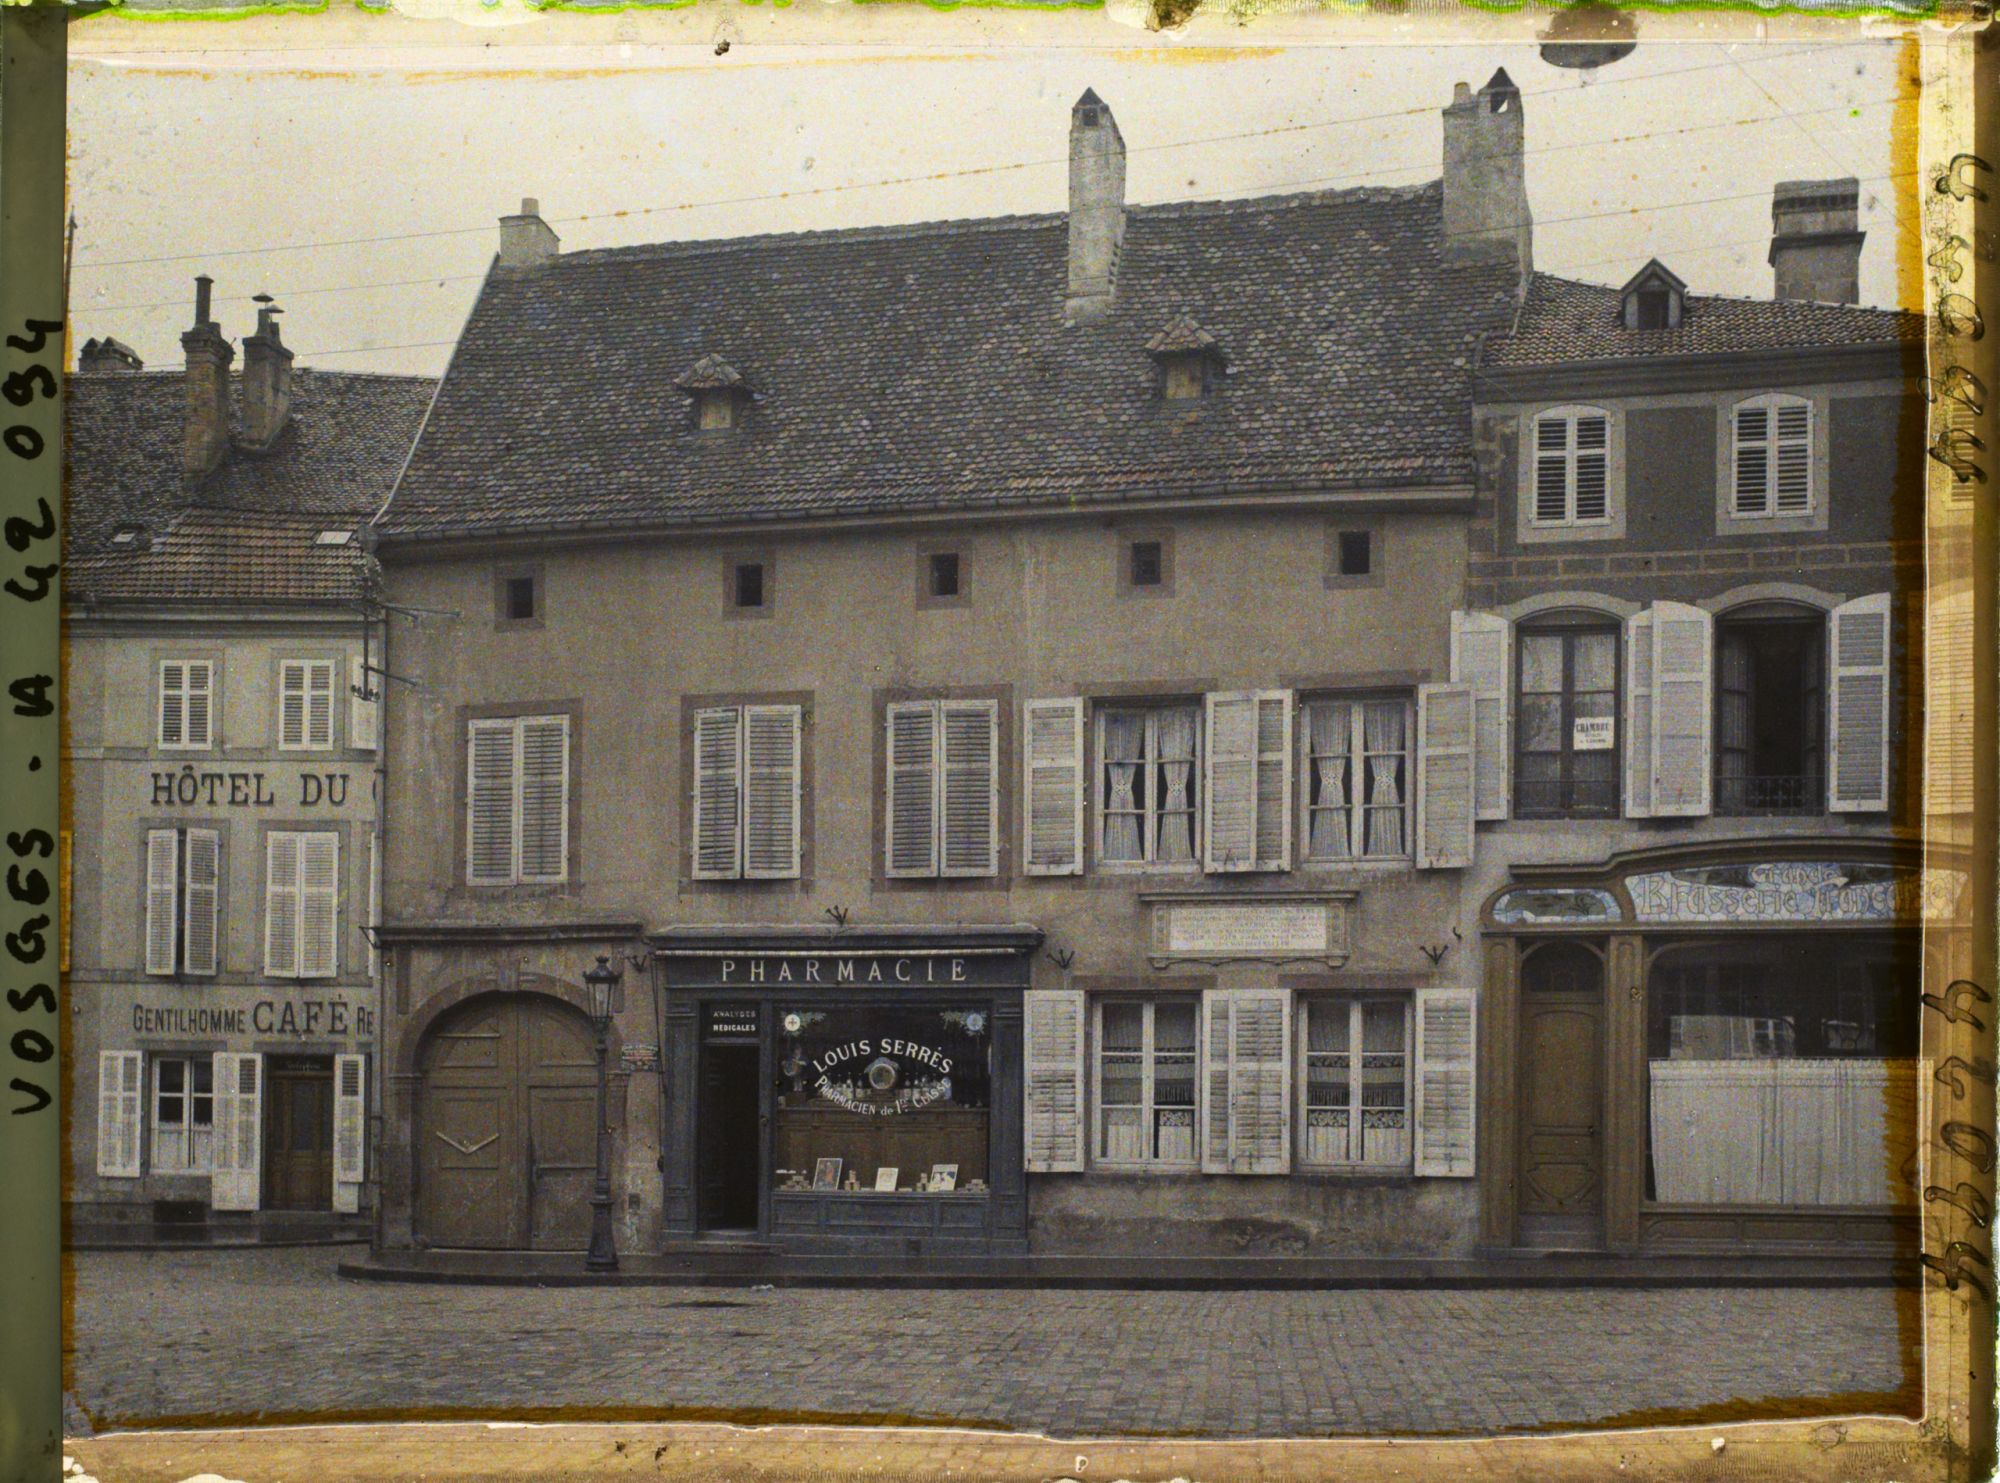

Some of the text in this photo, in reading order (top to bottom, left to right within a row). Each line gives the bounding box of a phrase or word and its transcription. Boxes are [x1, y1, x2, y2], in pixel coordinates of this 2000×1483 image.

[150, 764, 275, 807] HÔTEL
[300, 773, 350, 807] DU
[1640, 875, 1800, 915] Brasserie
[5, 828, 57, 1116] VOSGES
[721, 959, 967, 982] PHARMACIE
[132, 1003, 246, 1034] GENTILHOMME
[252, 993, 348, 1034] CAFÉ
[812, 1039, 871, 1073] LOUIS
[814, 1074, 876, 1116] PHARMACIEN
[880, 1104, 893, 1116] de
